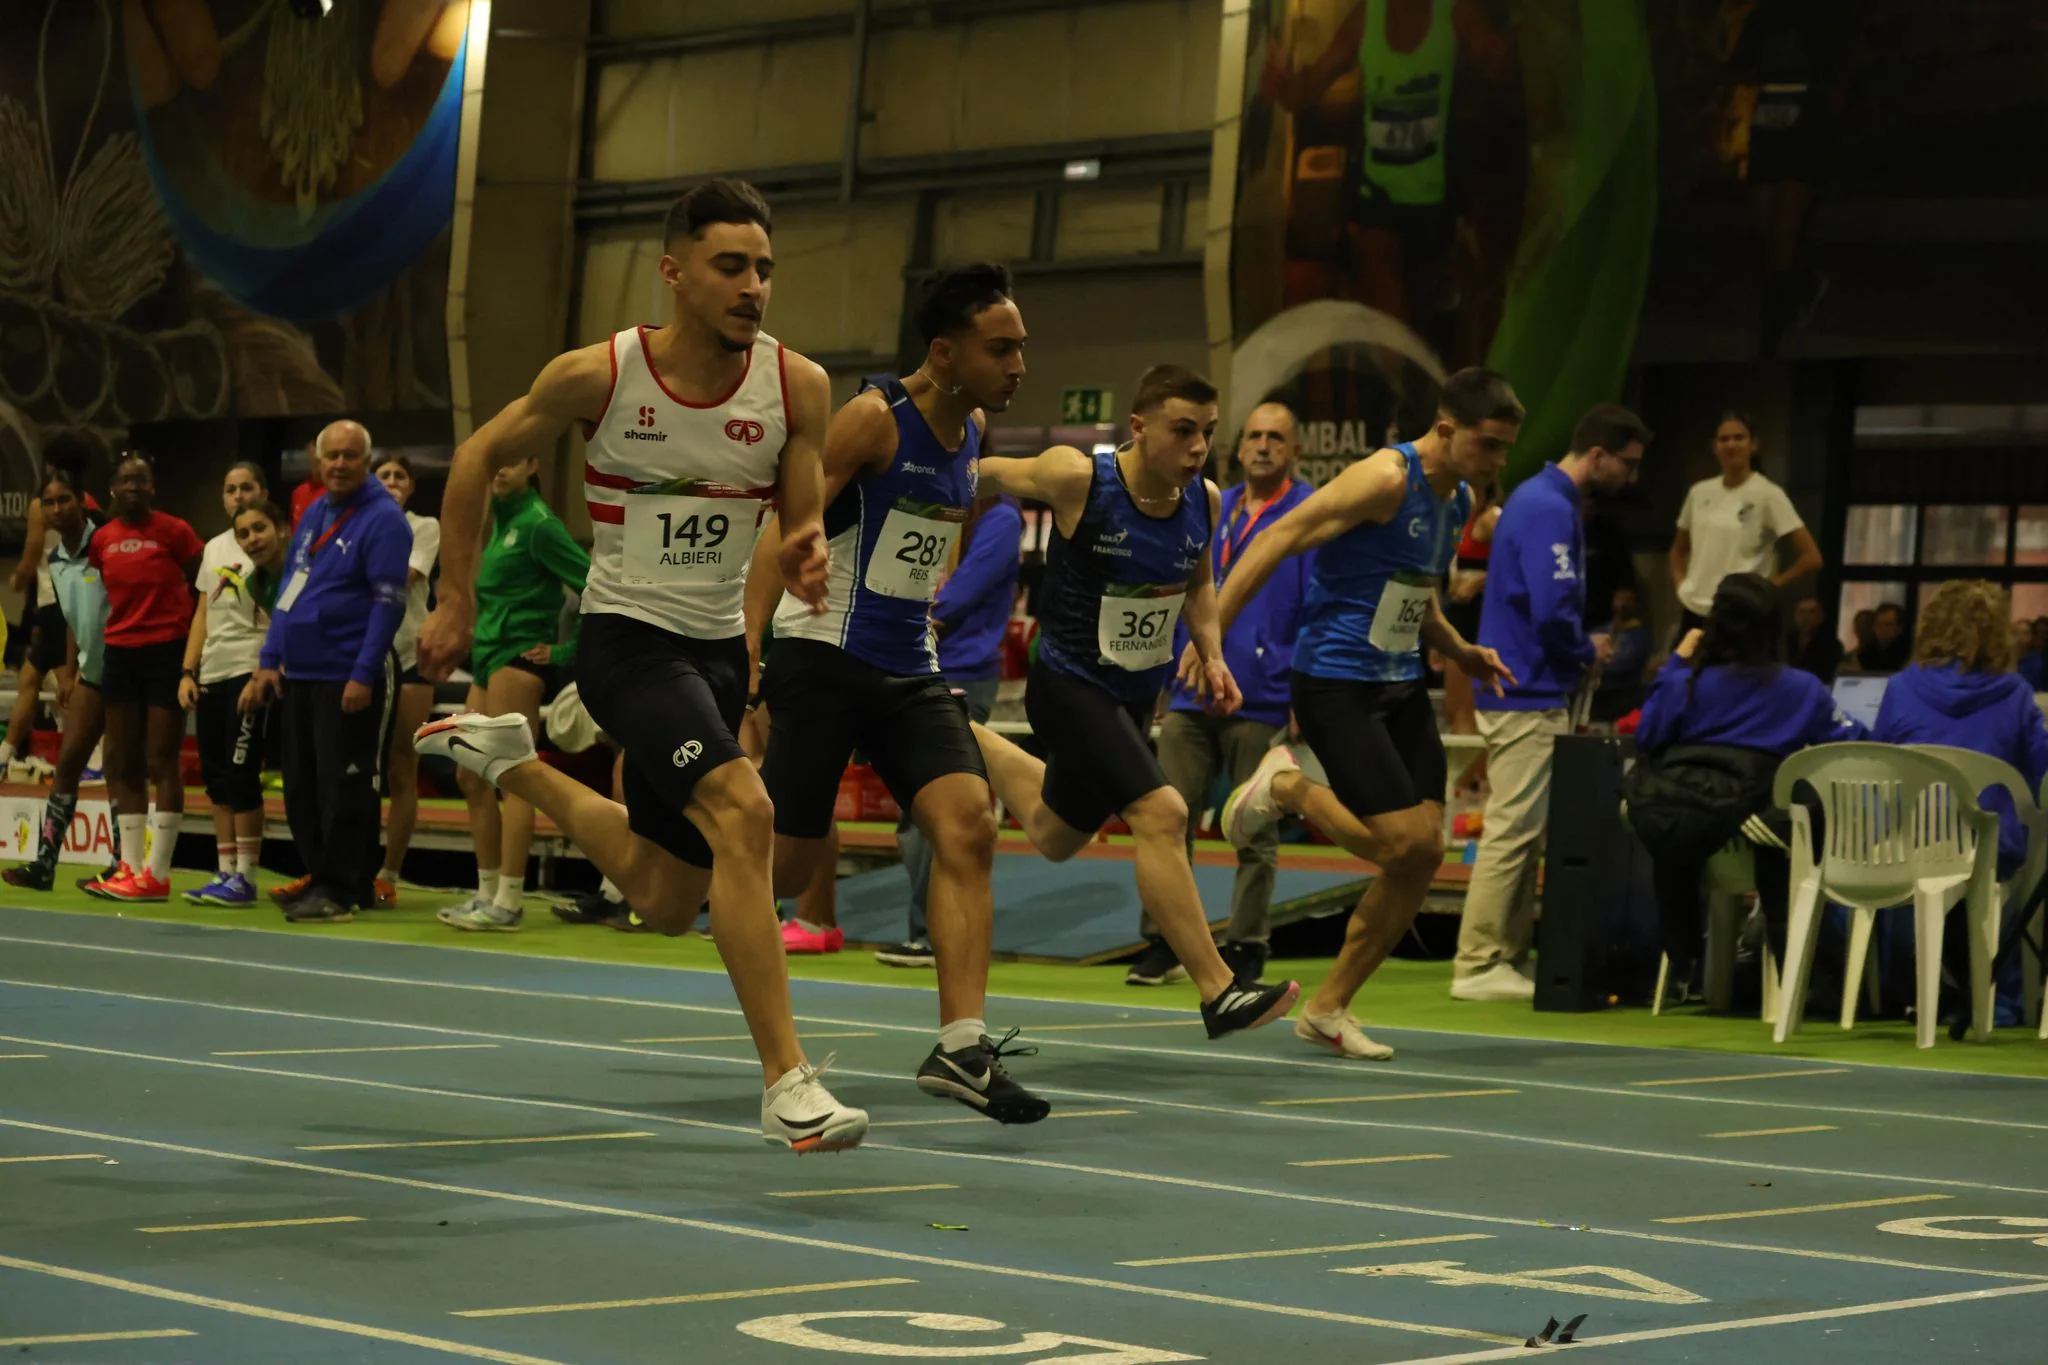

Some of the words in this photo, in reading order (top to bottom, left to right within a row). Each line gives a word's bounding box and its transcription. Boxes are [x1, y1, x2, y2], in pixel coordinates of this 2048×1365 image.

[623, 429, 668, 443] shamir
[656, 513, 729, 549] 149
[659, 551, 723, 566] ALBIERI
[908, 568, 930, 581] REIS
[1397, 598, 1429, 623] 162
[1118, 608, 1170, 639] 367
[62, 811, 114, 854] DA
